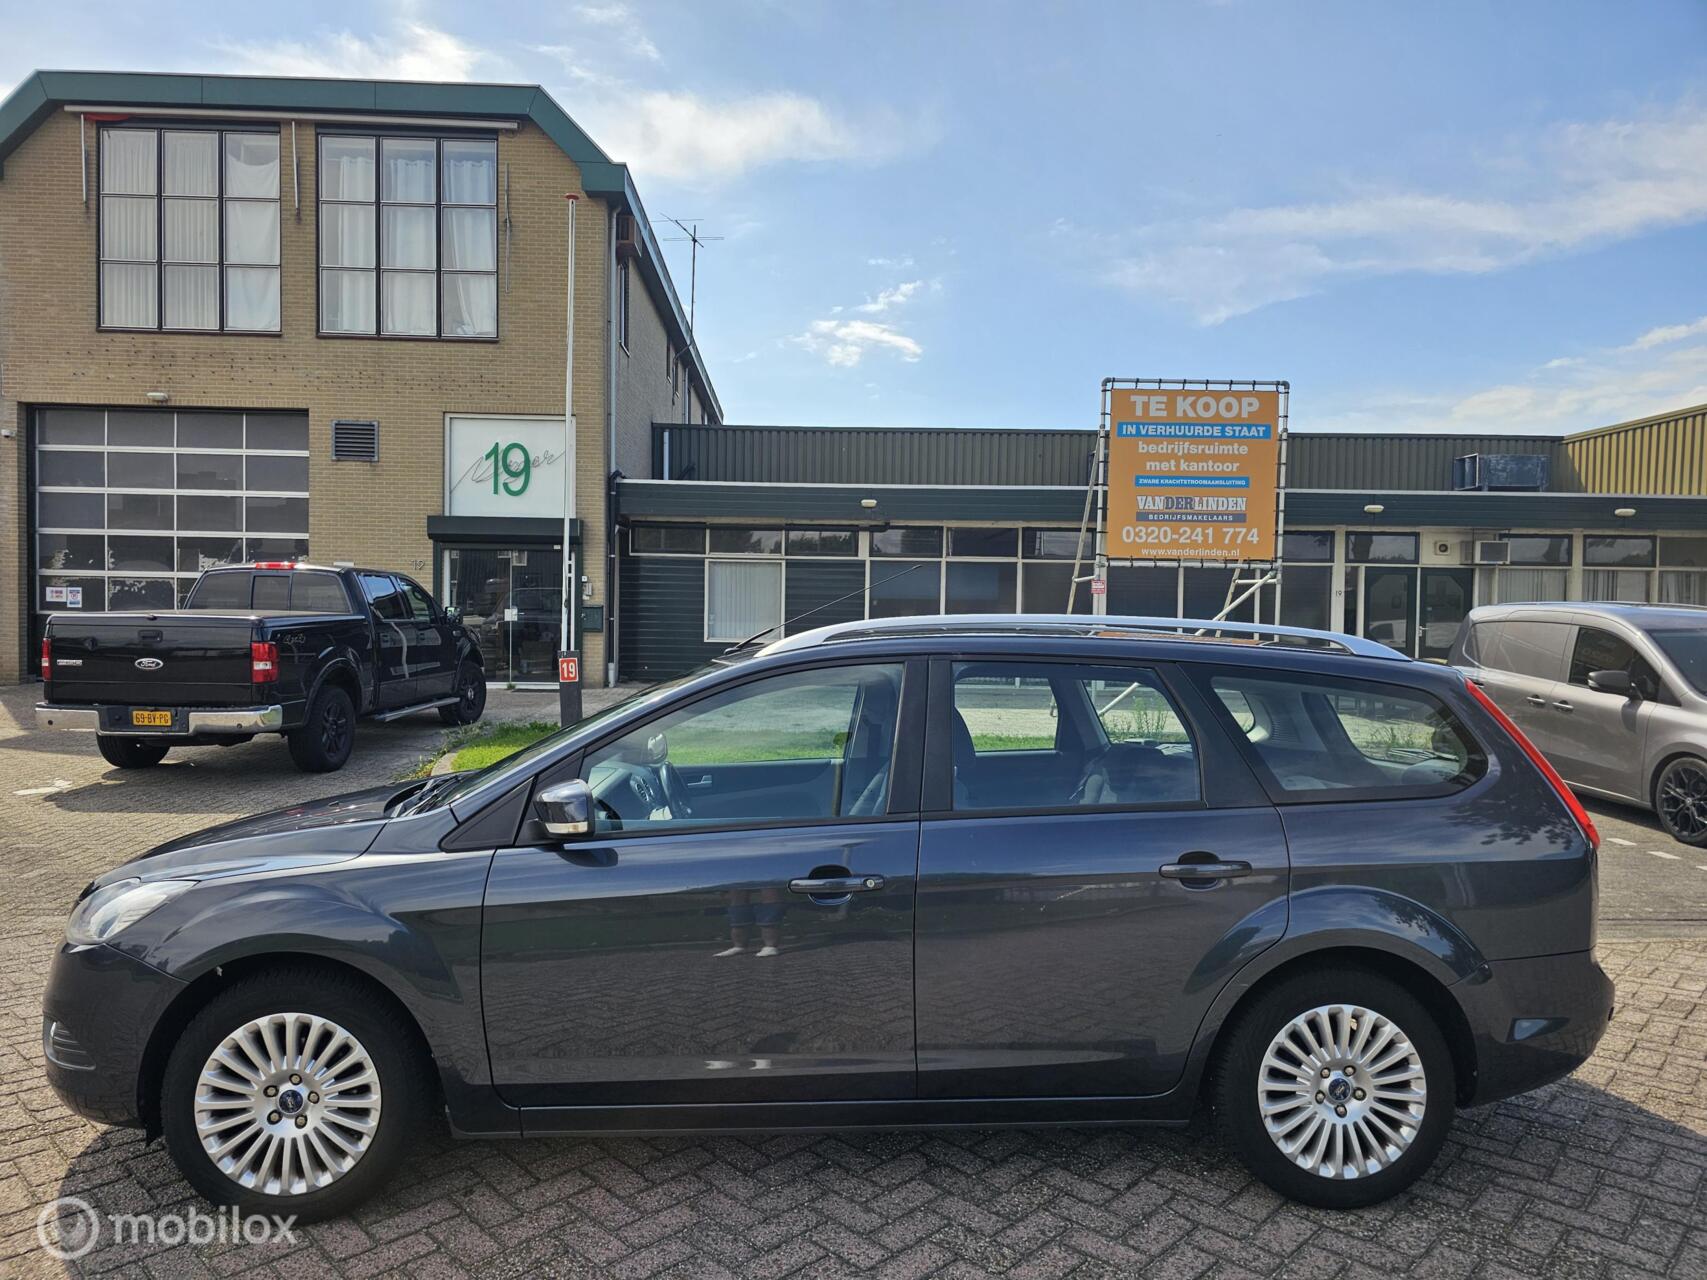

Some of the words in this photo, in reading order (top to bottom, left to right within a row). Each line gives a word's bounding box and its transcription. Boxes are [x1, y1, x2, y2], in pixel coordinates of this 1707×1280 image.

[1130, 395, 1168, 417] TE
[1176, 396, 1260, 418] KOOP
[1122, 425, 1136, 435] IN
[1140, 425, 1222, 436] VERHUURDE
[1225, 426, 1266, 437] STAAT
[1138, 441, 1249, 456] bedrijfsruimte
[484, 441, 531, 497] 19
[1146, 460, 1176, 471] met
[1180, 459, 1240, 472] kantoor
[1148, 514, 1234, 522] BEDRIJFSMAKELAARS
[1122, 526, 1214, 545] 0320-241
[1222, 526, 1260, 545] 774
[1141, 548, 1240, 558] www.vanderlinden.nl
[561, 661, 576, 678] 19
[135, 712, 169, 725] 69-BV-PG
